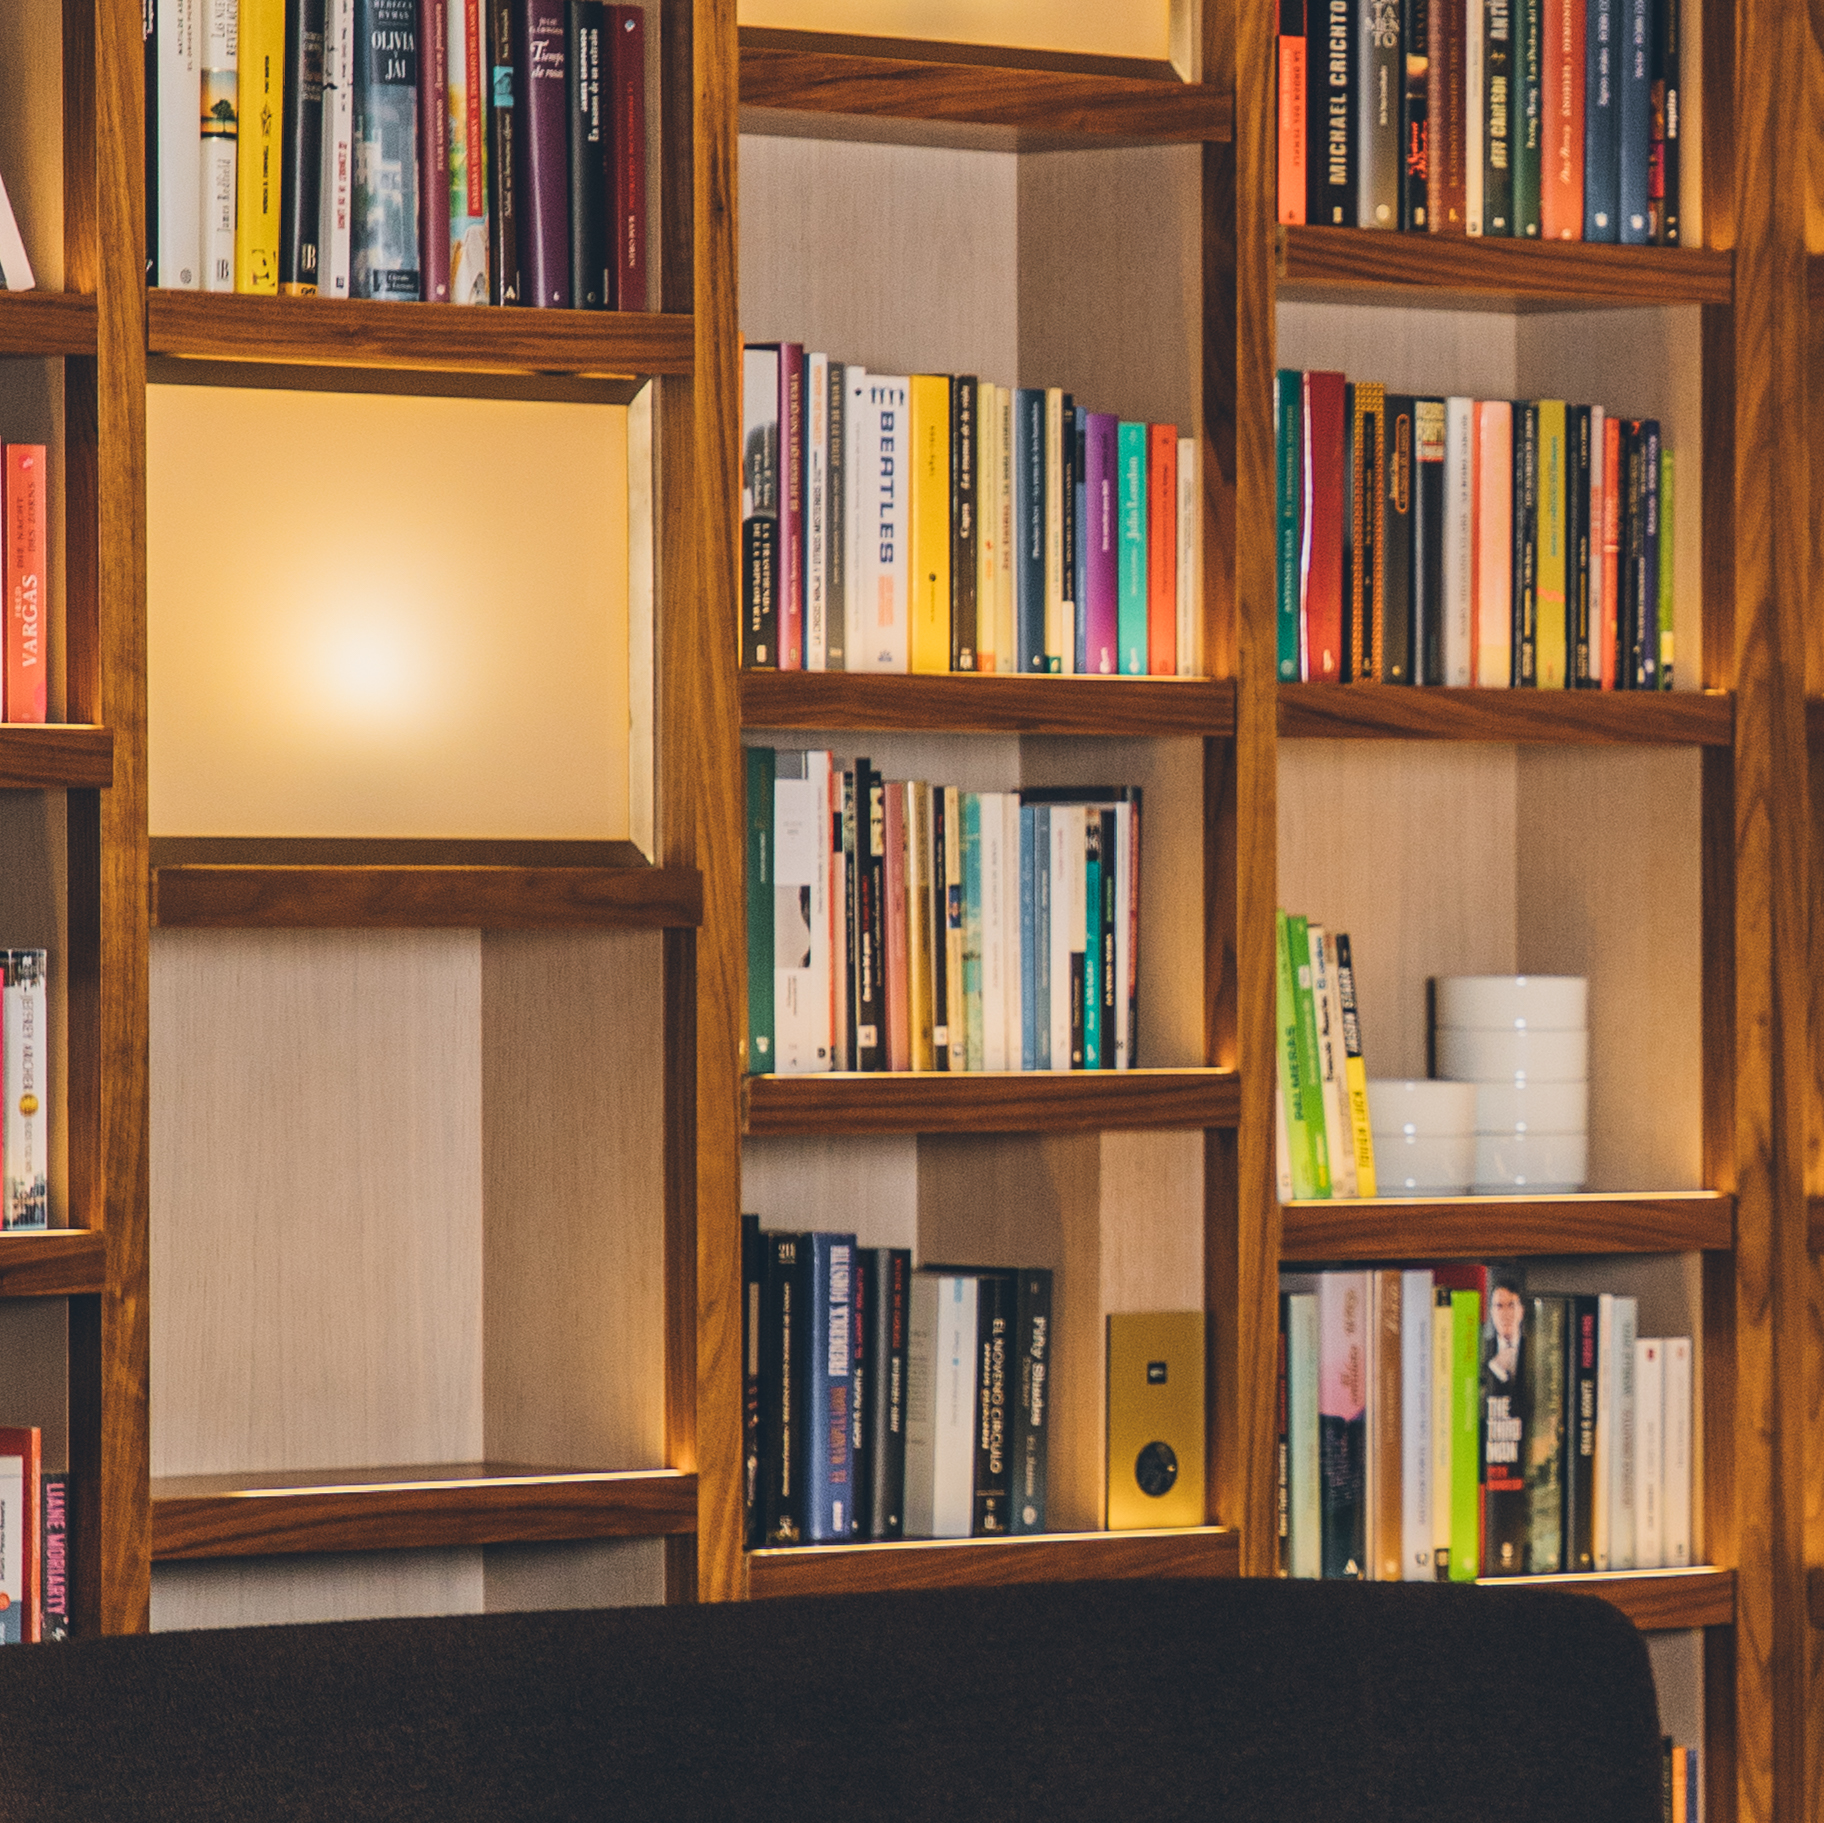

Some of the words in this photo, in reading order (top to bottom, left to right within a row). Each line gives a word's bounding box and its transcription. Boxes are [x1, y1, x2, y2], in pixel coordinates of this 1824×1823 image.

[371, 31, 415, 52] OLIVIA
[386, 58, 406, 80] JAI
[1329, 93, 1347, 185] MICHAEL
[879, 411, 894, 563] BEATLES
[22, 575, 38, 667] VARGAS
[1286, 1026, 1304, 1121] PALMERAS
[46, 1533, 65, 1615] MORIARTY
